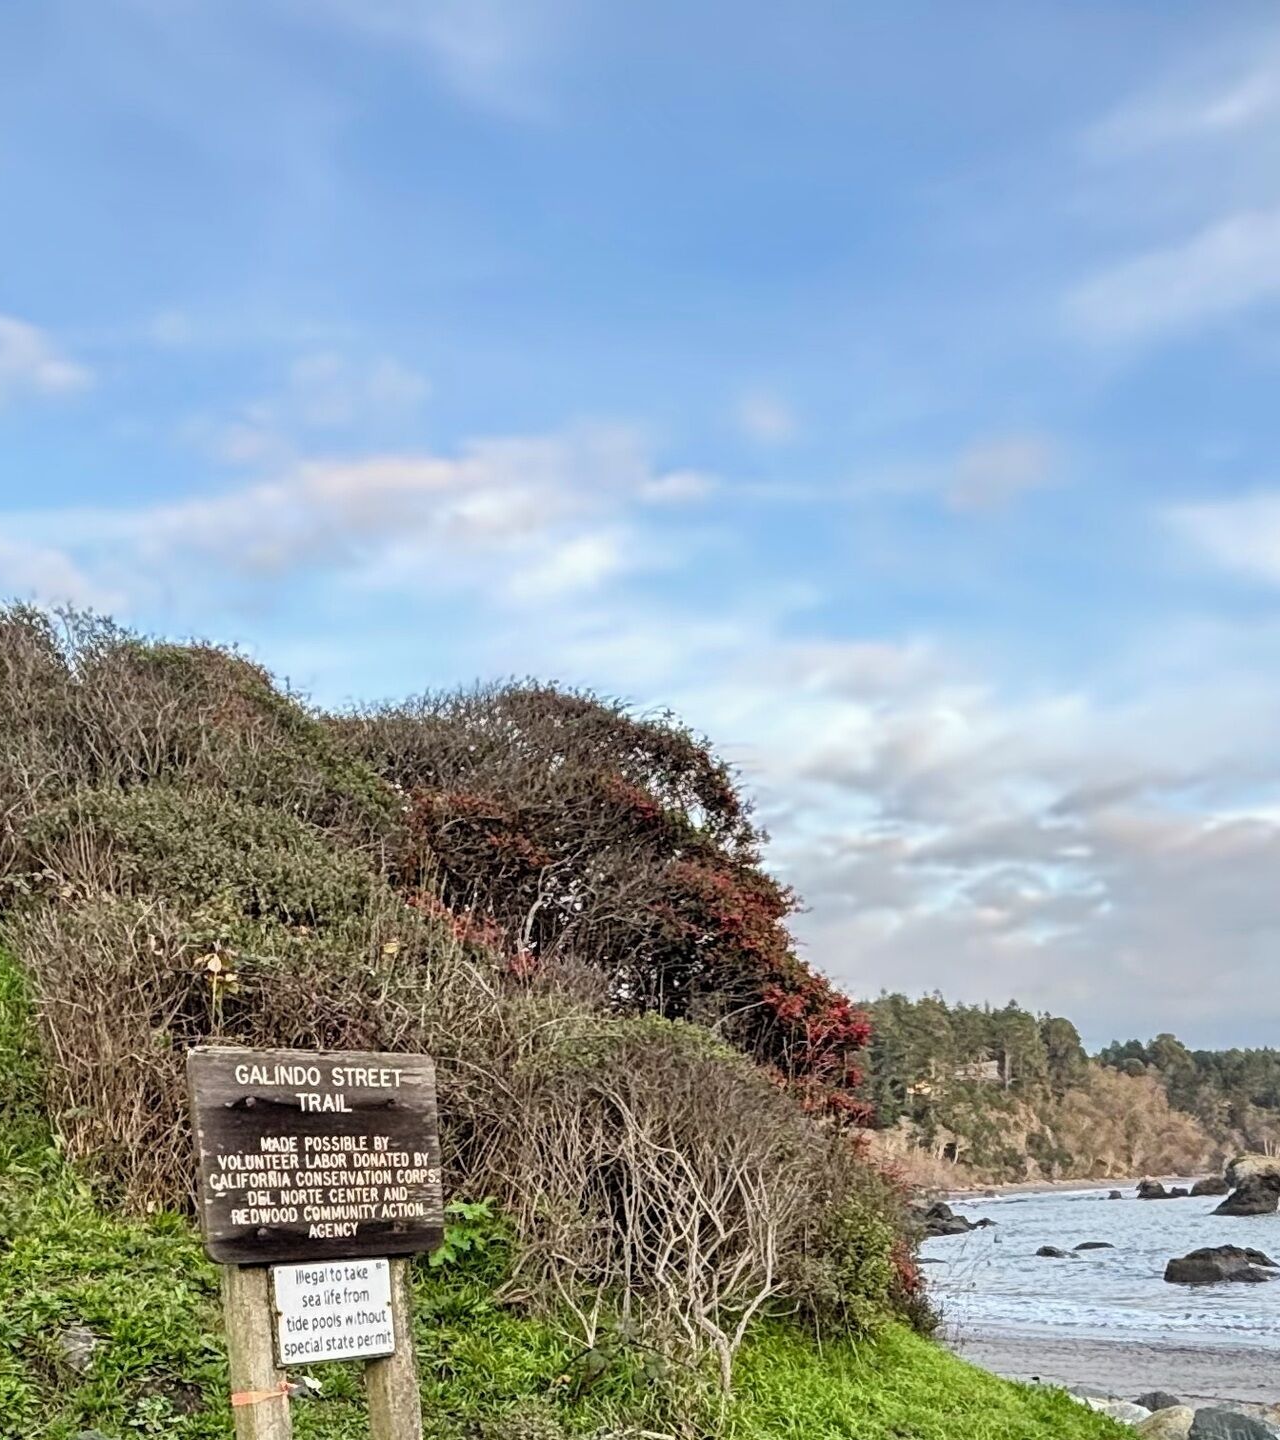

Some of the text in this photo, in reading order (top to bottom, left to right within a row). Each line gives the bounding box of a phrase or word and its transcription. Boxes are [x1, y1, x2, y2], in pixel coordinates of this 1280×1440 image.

[235, 1065, 402, 1087] GALINDO STREET
[296, 1092, 353, 1113] TRAIL
[260, 1135, 389, 1152] MADE POSSIBLE BY
[217, 1152, 429, 1170] VOLUNTEER LABOR DONATED BY
[209, 1170, 291, 1191] CALIFORNIA
[295, 1169, 392, 1187] CONSERVATION
[247, 1186, 408, 1206] DEL NORTE CENTER AND
[231, 1202, 424, 1225] REDWOOD COMMUNITY ACTION
[308, 1221, 359, 1239] AGENCY
[295, 1267, 329, 1285] Illegal
[329, 1267, 342, 1282] to
[344, 1265, 369, 1281] take
[302, 1287, 370, 1308] sea life from
[286, 1309, 387, 1332] tide pools without
[284, 1330, 392, 1357] special state permit
